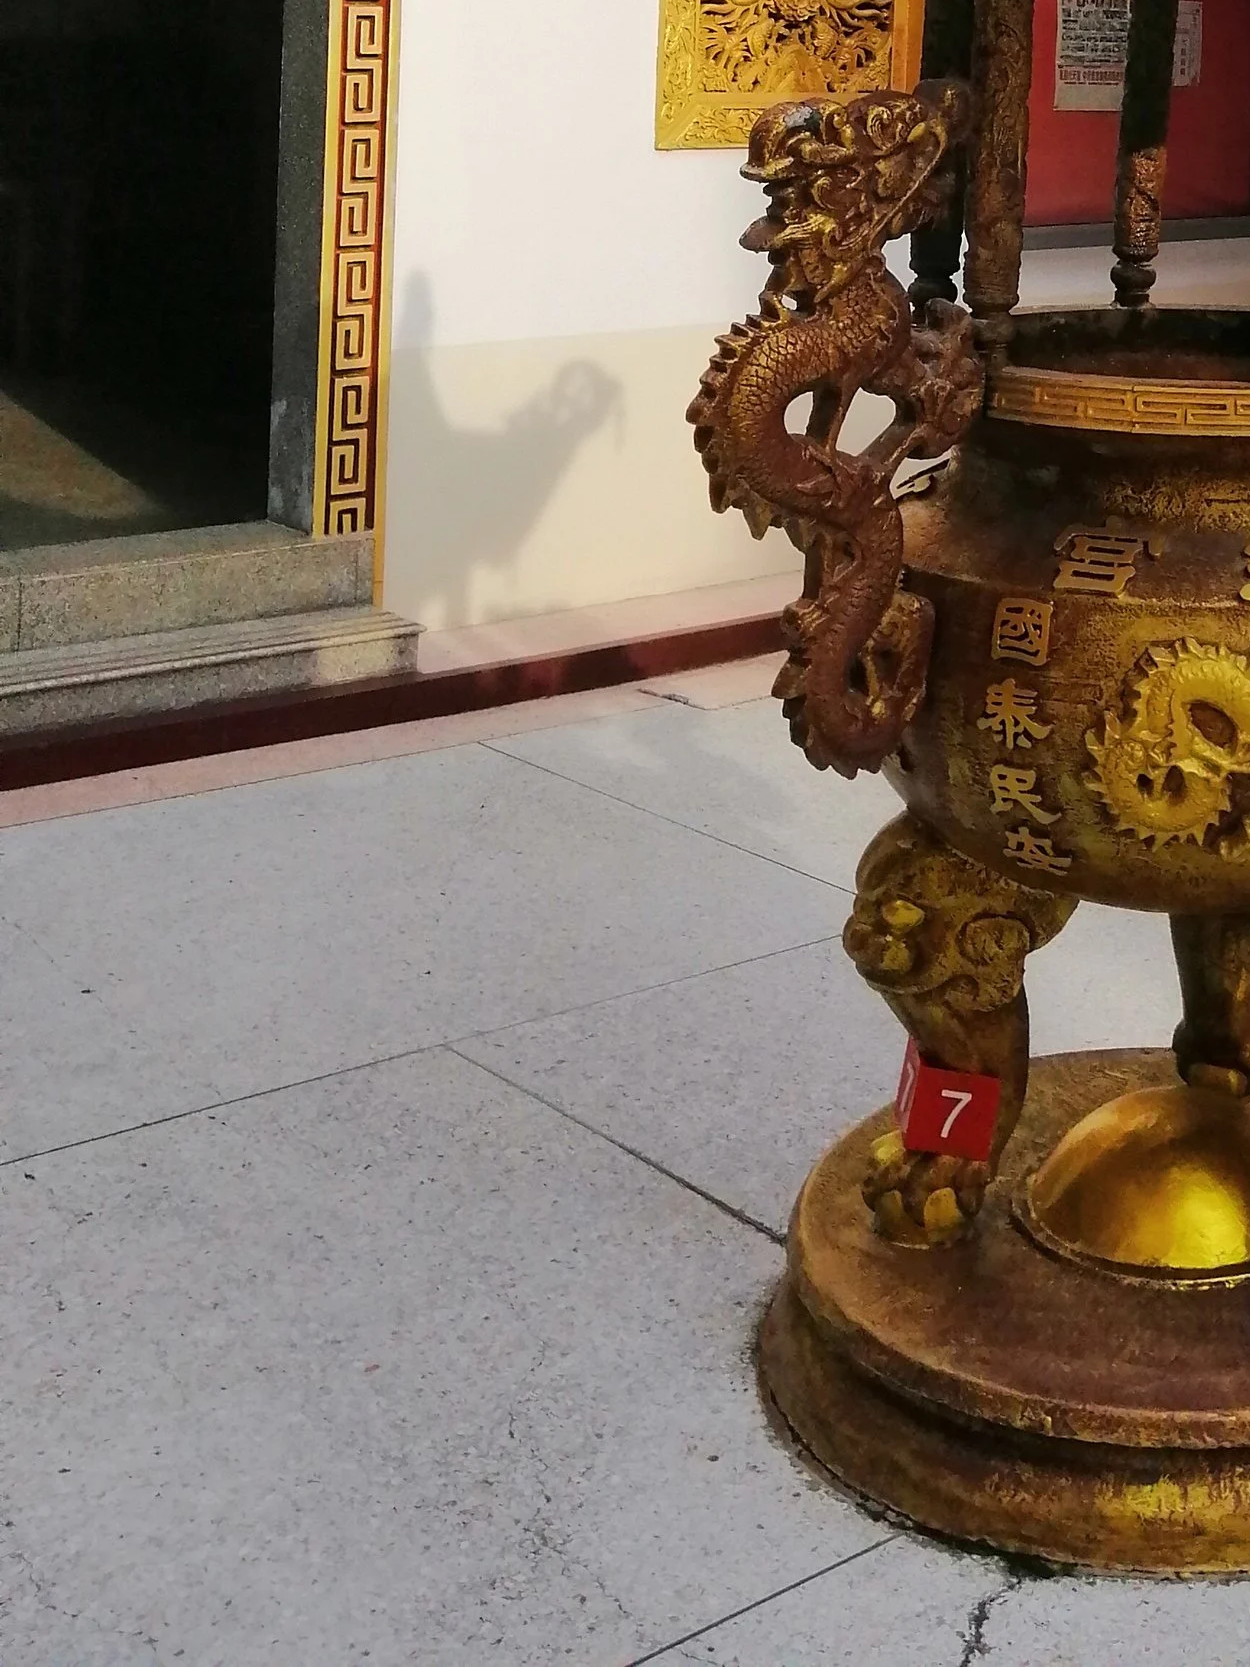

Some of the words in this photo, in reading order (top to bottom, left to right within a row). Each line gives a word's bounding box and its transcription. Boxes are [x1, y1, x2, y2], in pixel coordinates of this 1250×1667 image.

[977, 597, 1073, 876] 國泰民安
[940, 1089, 973, 1138] 7
